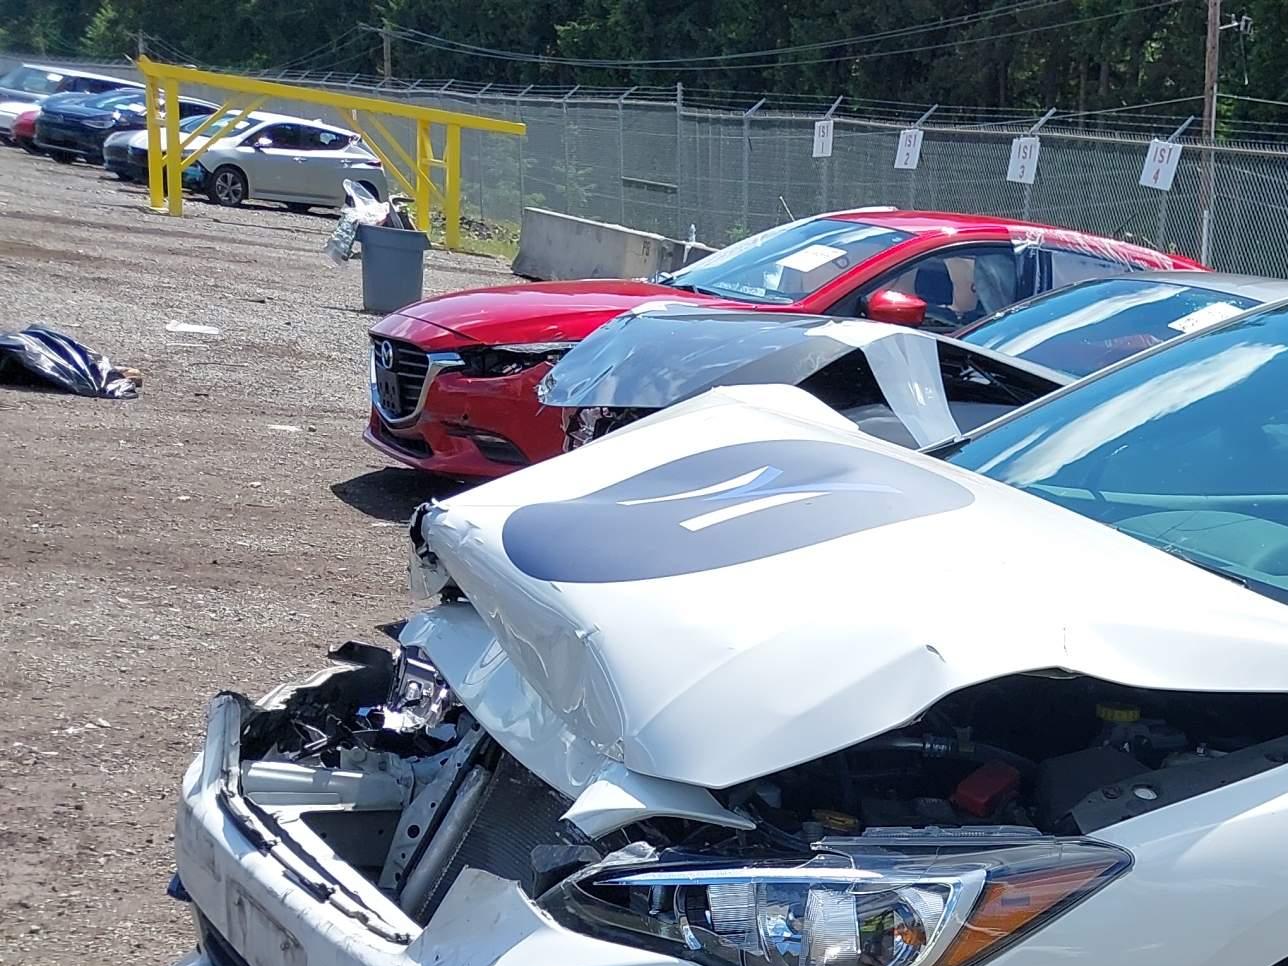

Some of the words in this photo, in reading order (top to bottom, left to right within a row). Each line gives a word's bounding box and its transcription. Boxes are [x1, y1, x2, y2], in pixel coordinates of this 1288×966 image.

[903, 152, 911, 166] 2
[1018, 164, 1026, 179] 3
[1151, 167, 1161, 185] 4
